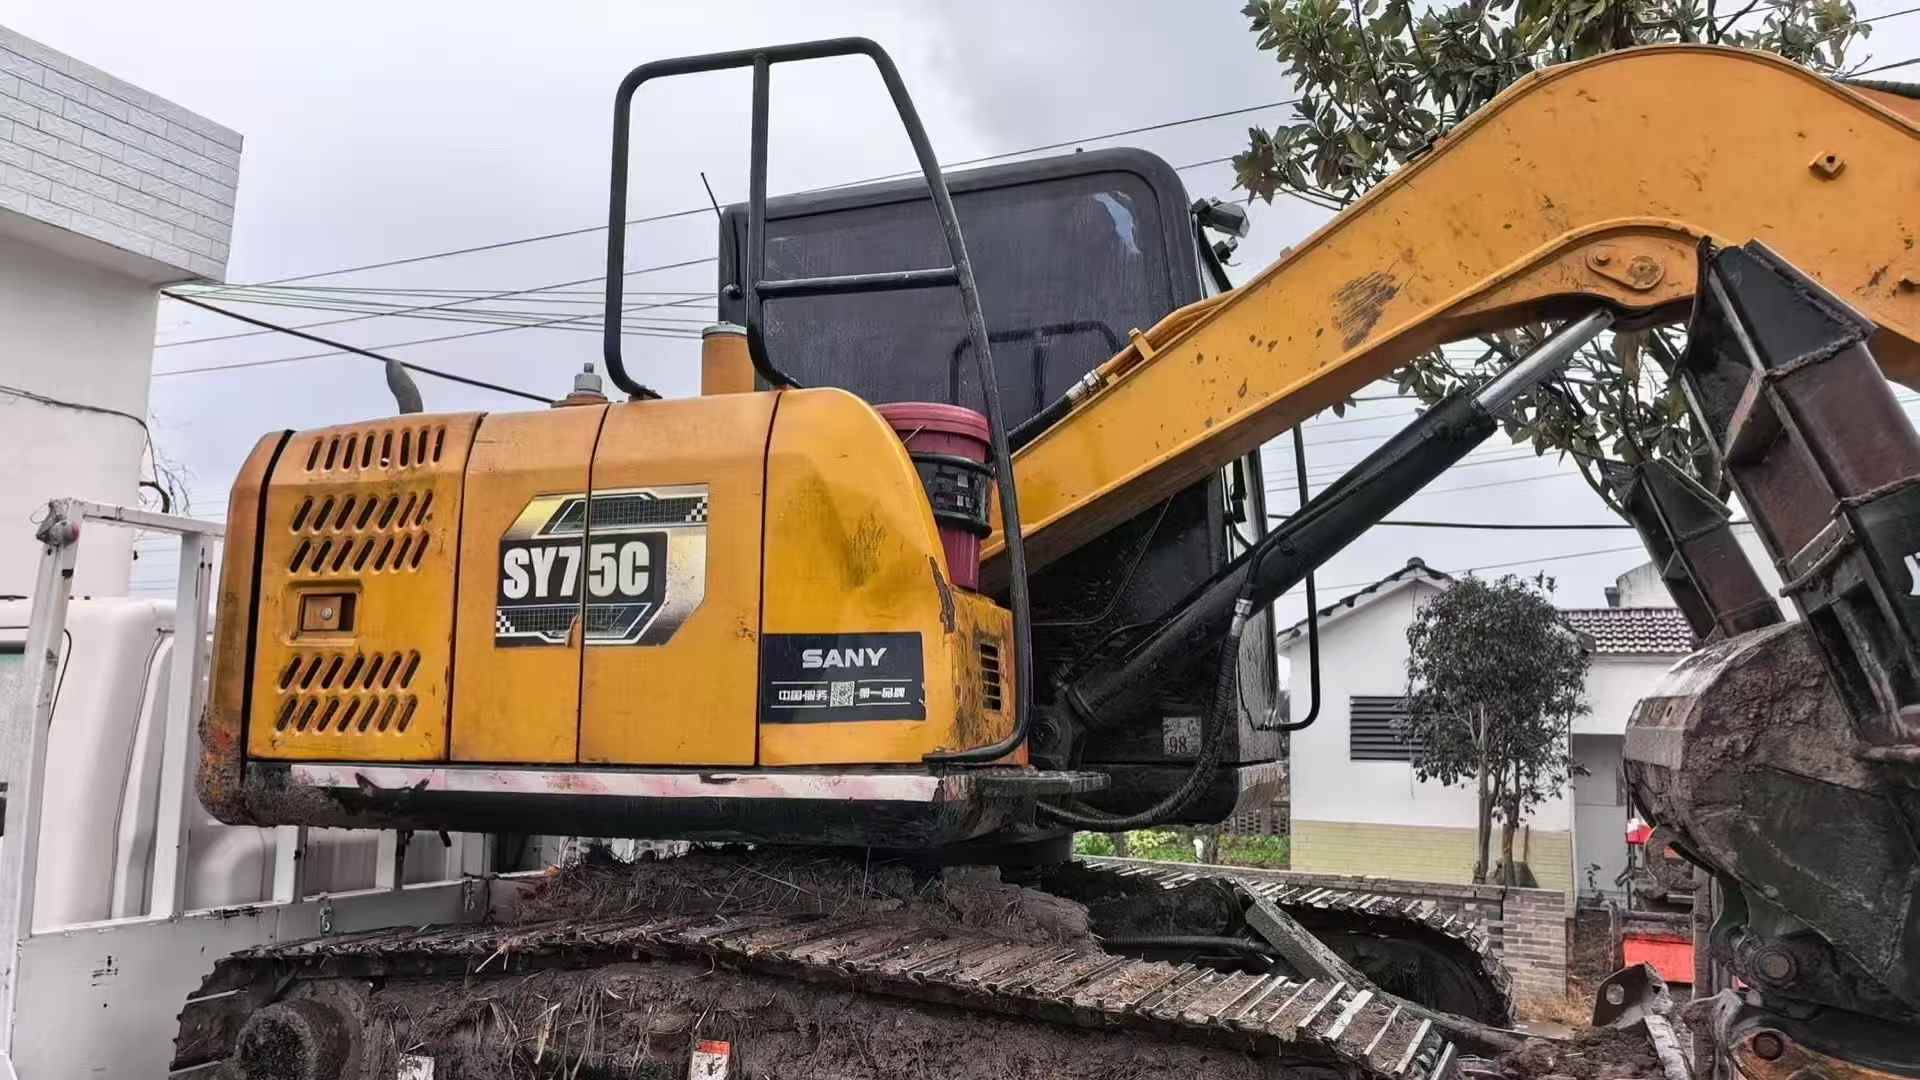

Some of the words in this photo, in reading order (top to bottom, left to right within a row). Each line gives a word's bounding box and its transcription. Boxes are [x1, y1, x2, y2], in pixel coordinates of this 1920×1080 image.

[503, 540, 650, 600] SY75C
[802, 648, 888, 668] SANY
[1169, 735, 1188, 753] 98
